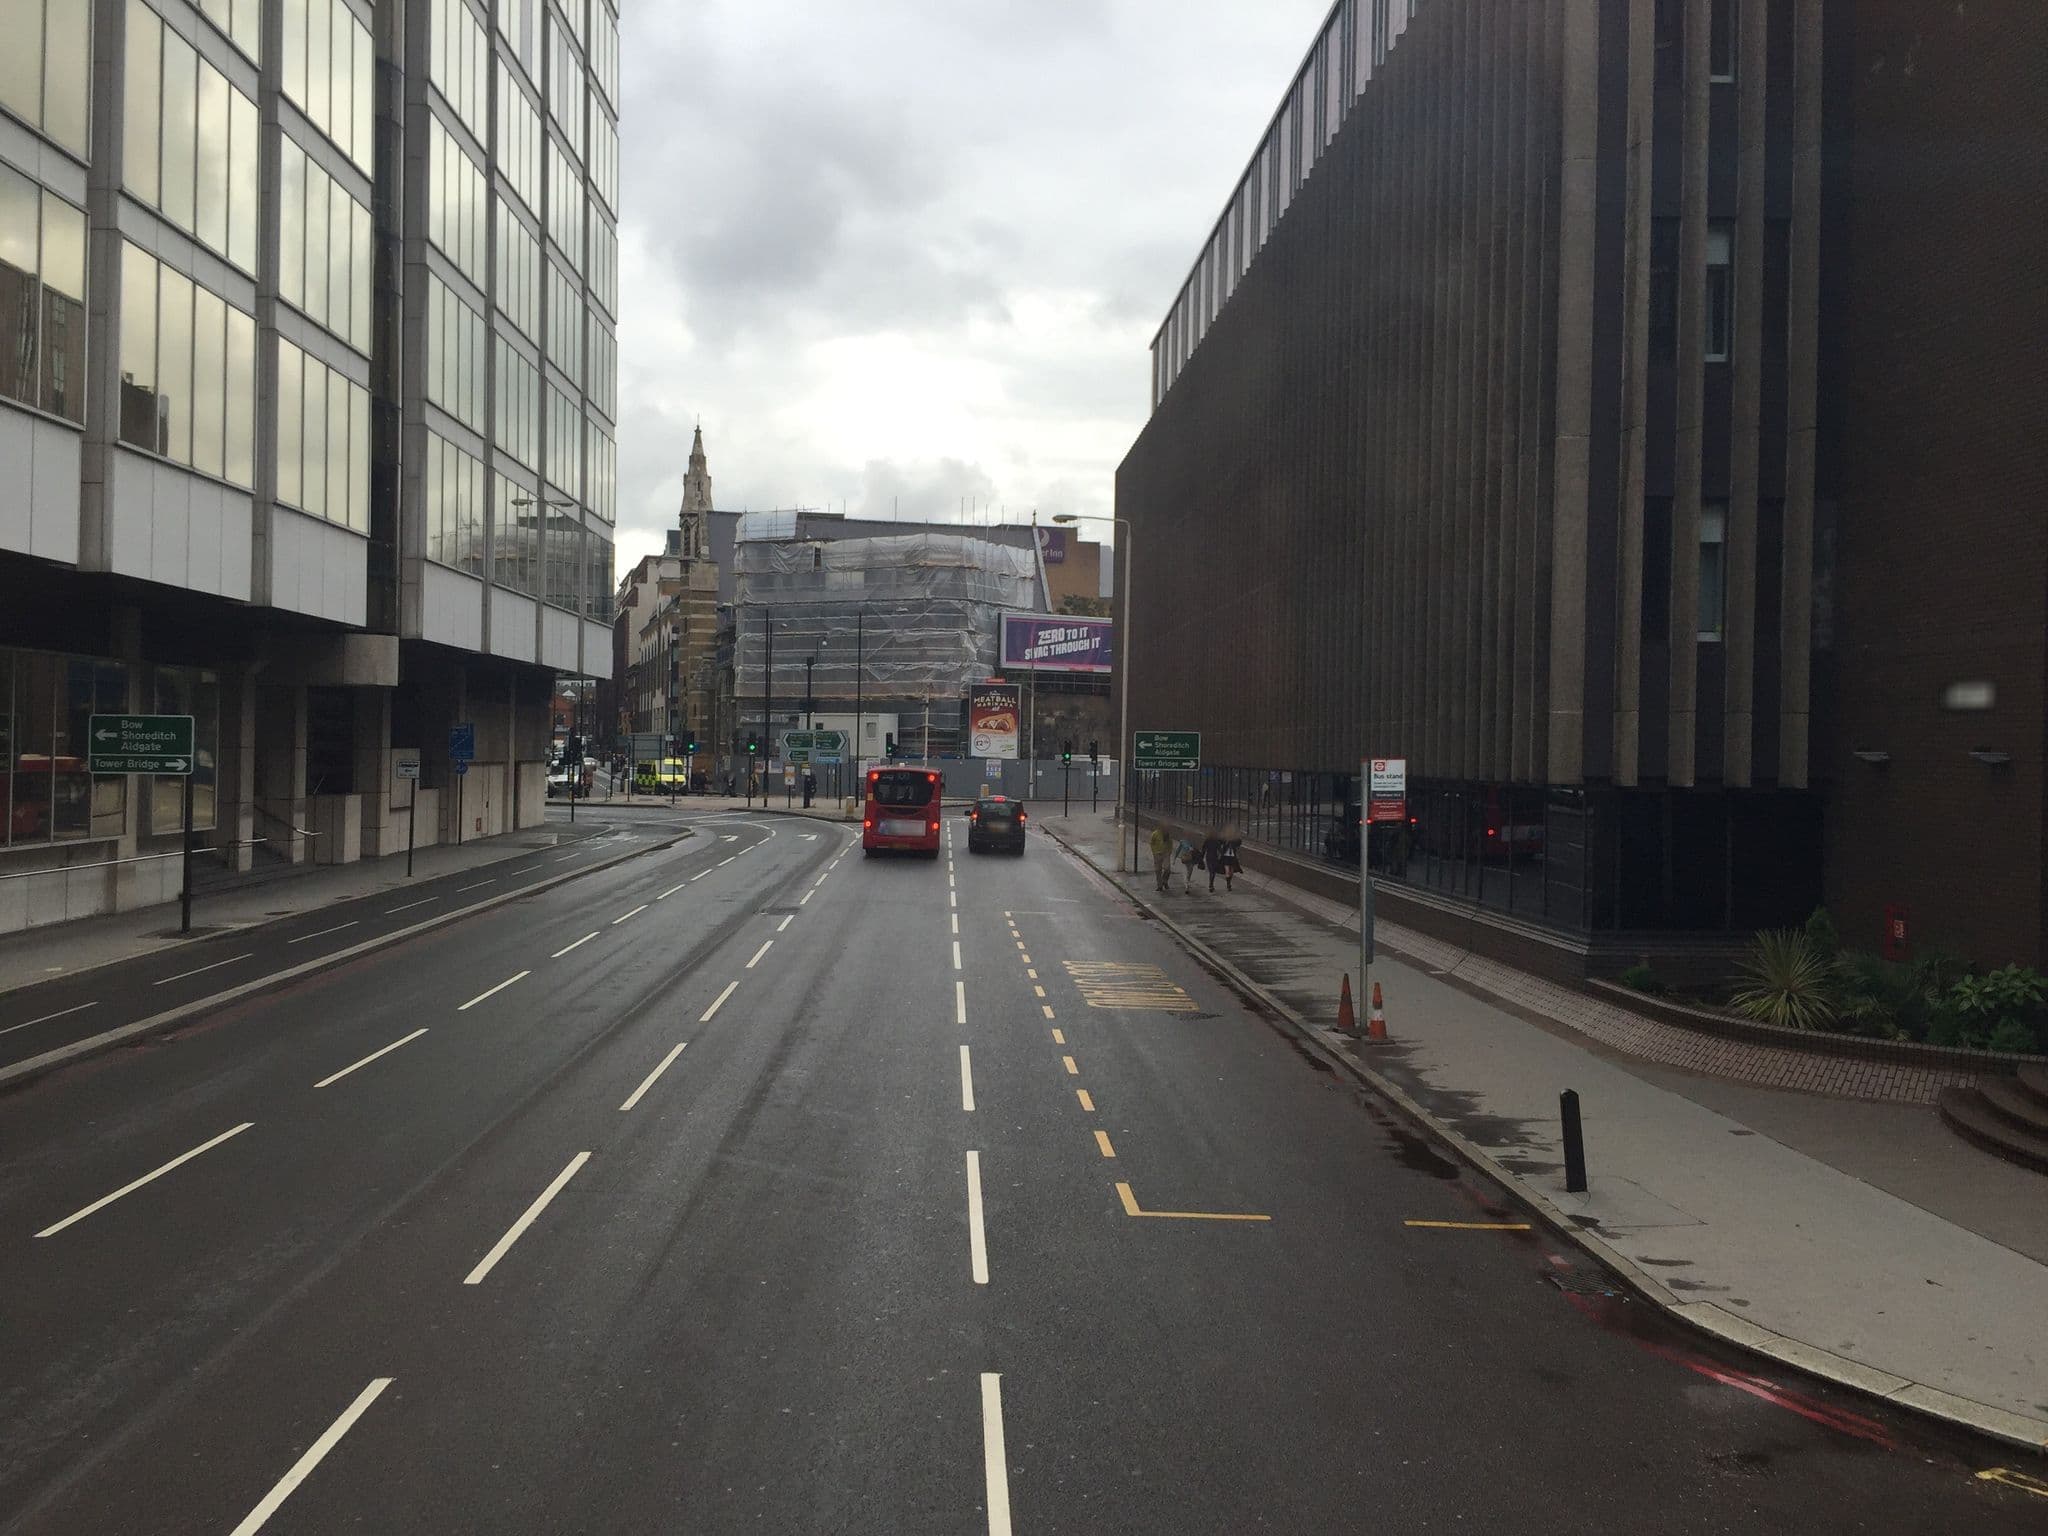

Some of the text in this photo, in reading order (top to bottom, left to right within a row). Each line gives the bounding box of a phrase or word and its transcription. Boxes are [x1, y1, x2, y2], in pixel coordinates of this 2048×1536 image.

[1038, 627, 1089, 645] ZERO TO IT
[1050, 639, 1090, 656] THROUGH
[1091, 637, 1101, 648] IT
[974, 696, 1016, 704] MEATBALL
[121, 720, 143, 729] Bow
[121, 731, 177, 740] Shoreditch
[121, 742, 162, 753] Aldgate
[95, 759, 161, 770] Tower Bridge
[1158, 760, 1179, 768] Bridge
